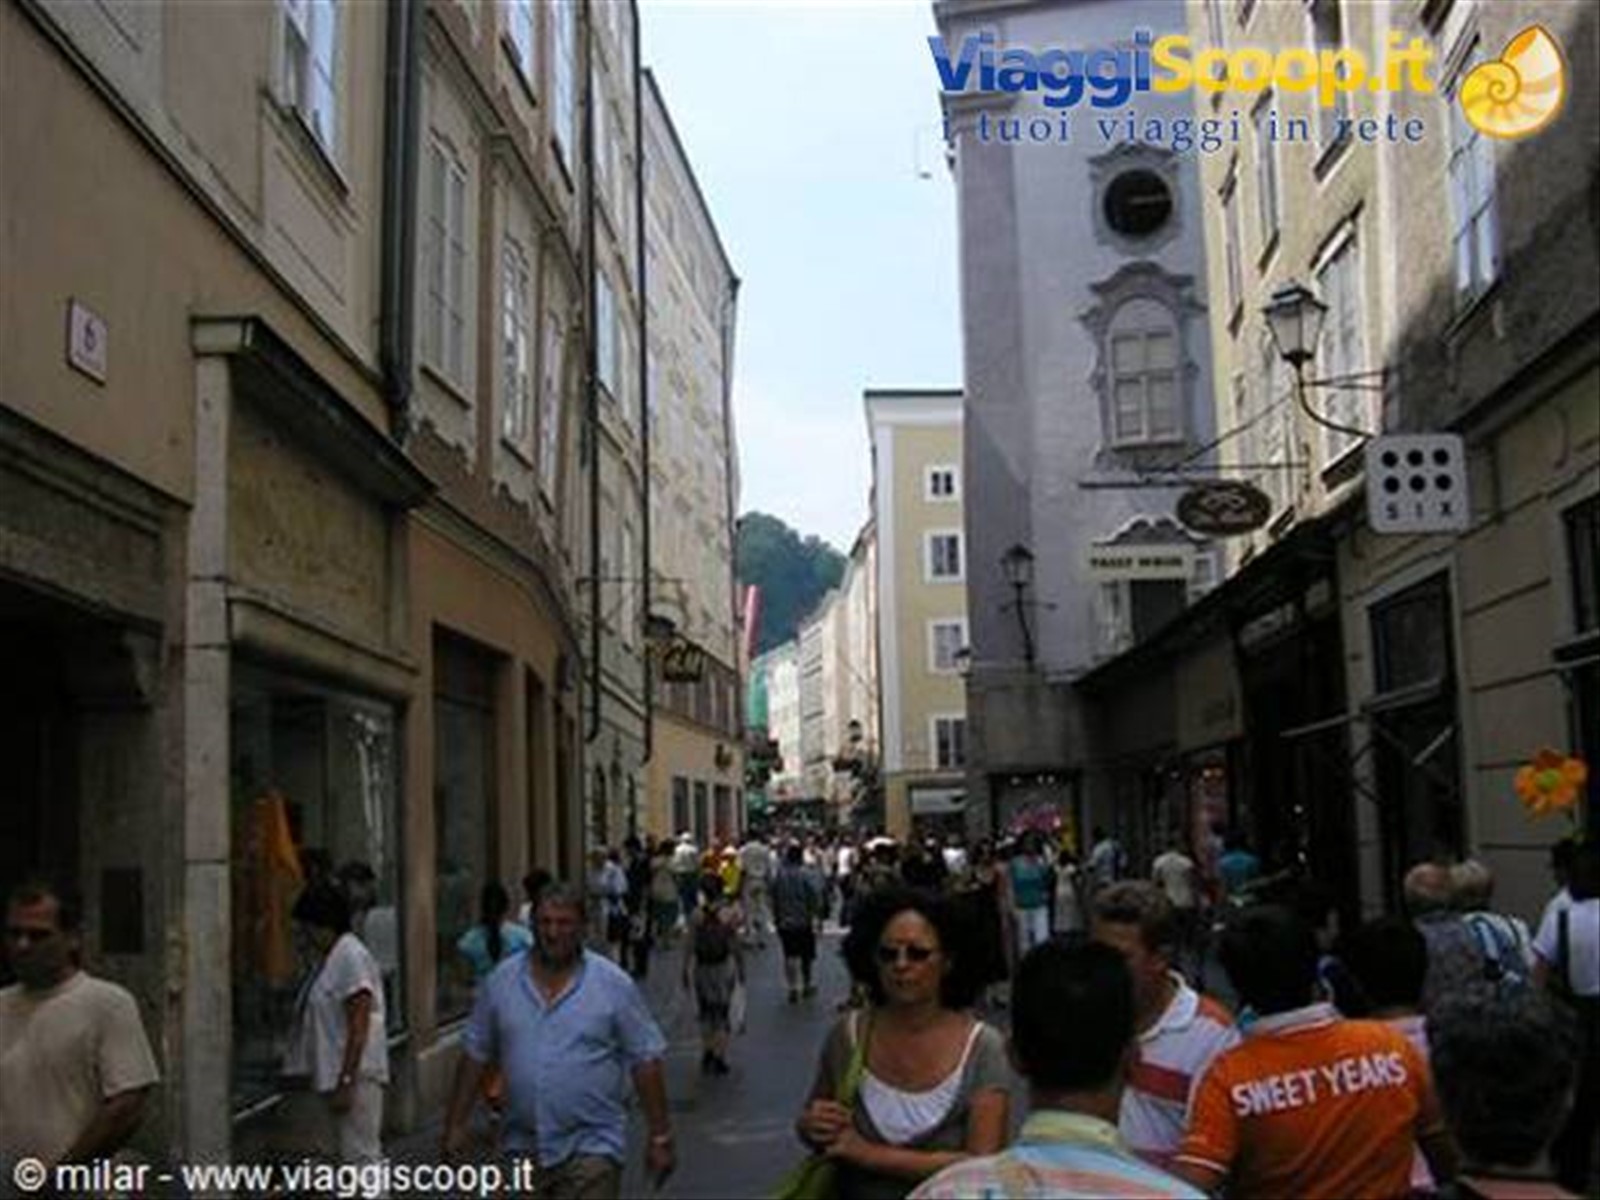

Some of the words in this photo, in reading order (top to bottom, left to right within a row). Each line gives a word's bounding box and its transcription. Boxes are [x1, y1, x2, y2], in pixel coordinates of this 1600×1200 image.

[1385, 501, 1453, 520] SIX
[1231, 1068, 1317, 1117] SWEET
[1320, 1051, 1407, 1096] YEARS
